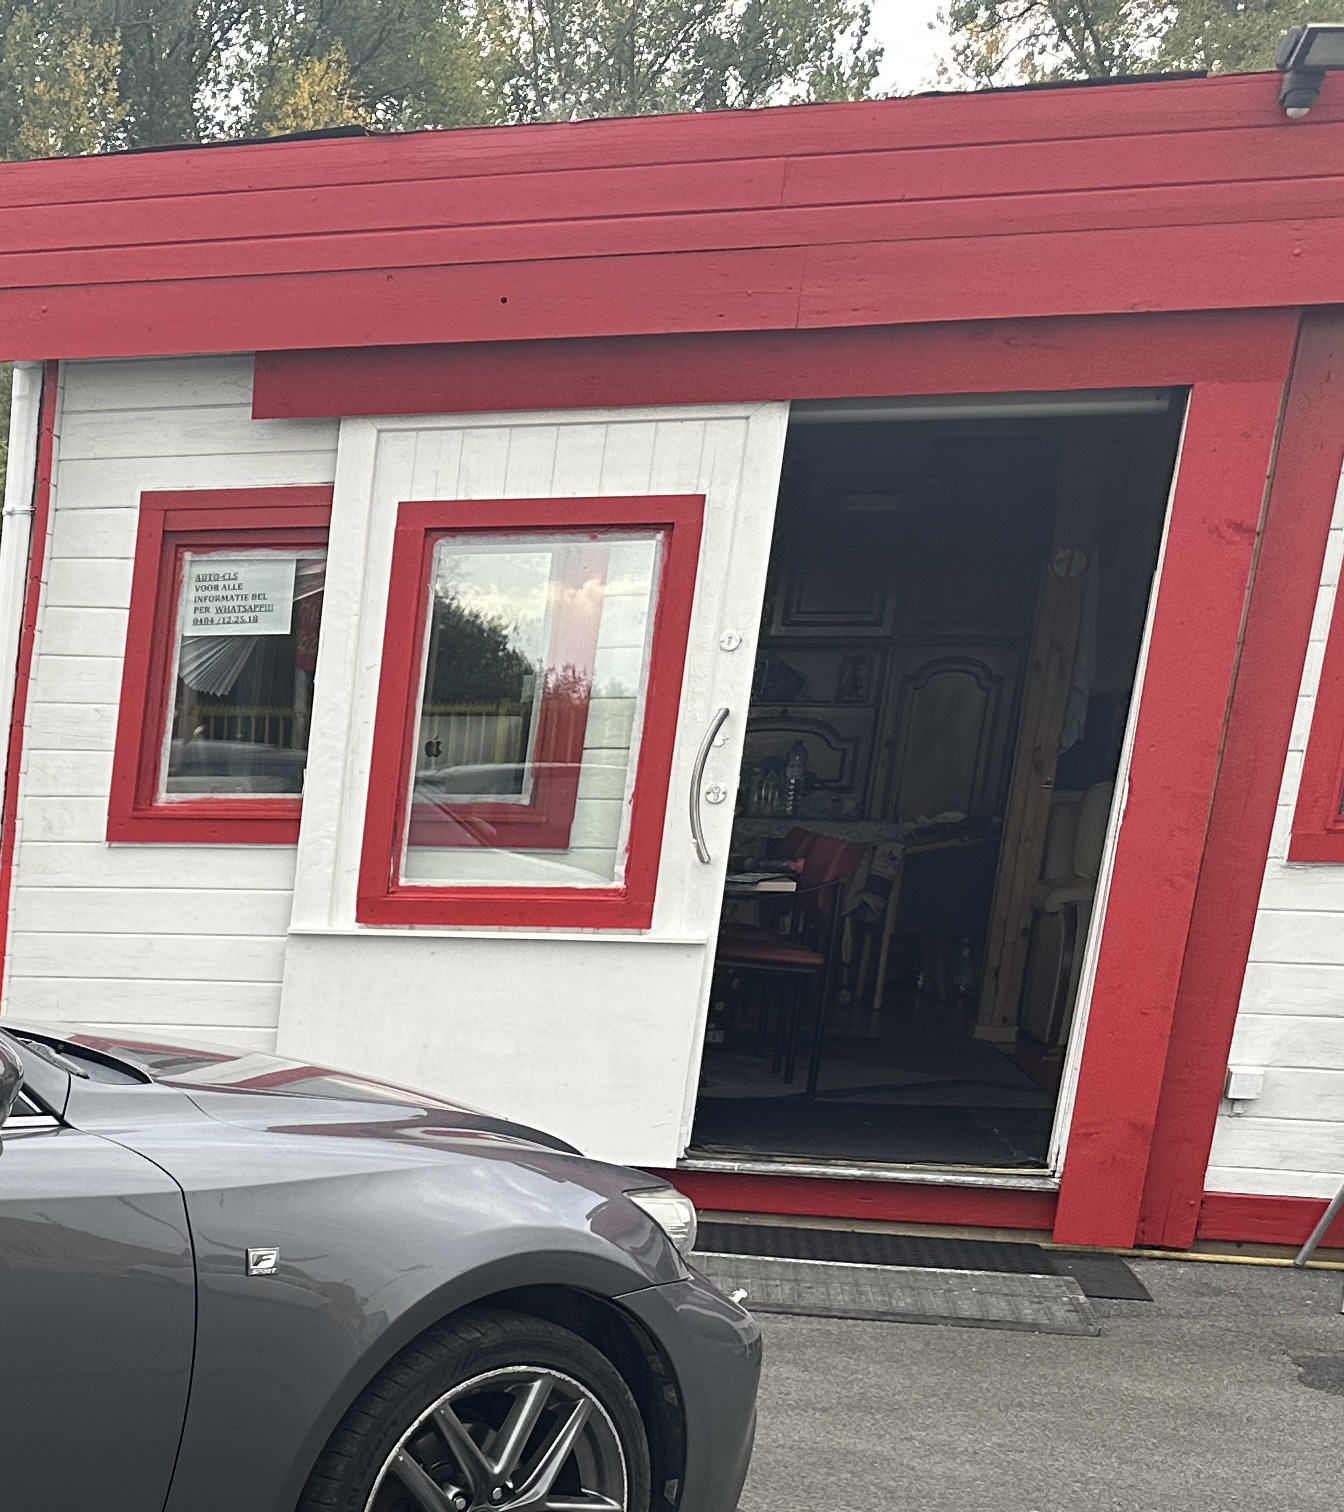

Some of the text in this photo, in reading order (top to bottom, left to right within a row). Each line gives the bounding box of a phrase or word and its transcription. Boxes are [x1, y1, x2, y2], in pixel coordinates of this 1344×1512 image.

[195, 583, 243, 592] VOOR ALLE
[194, 593, 268, 603] INFORMATIE BEL
[193, 606, 210, 614] PER
